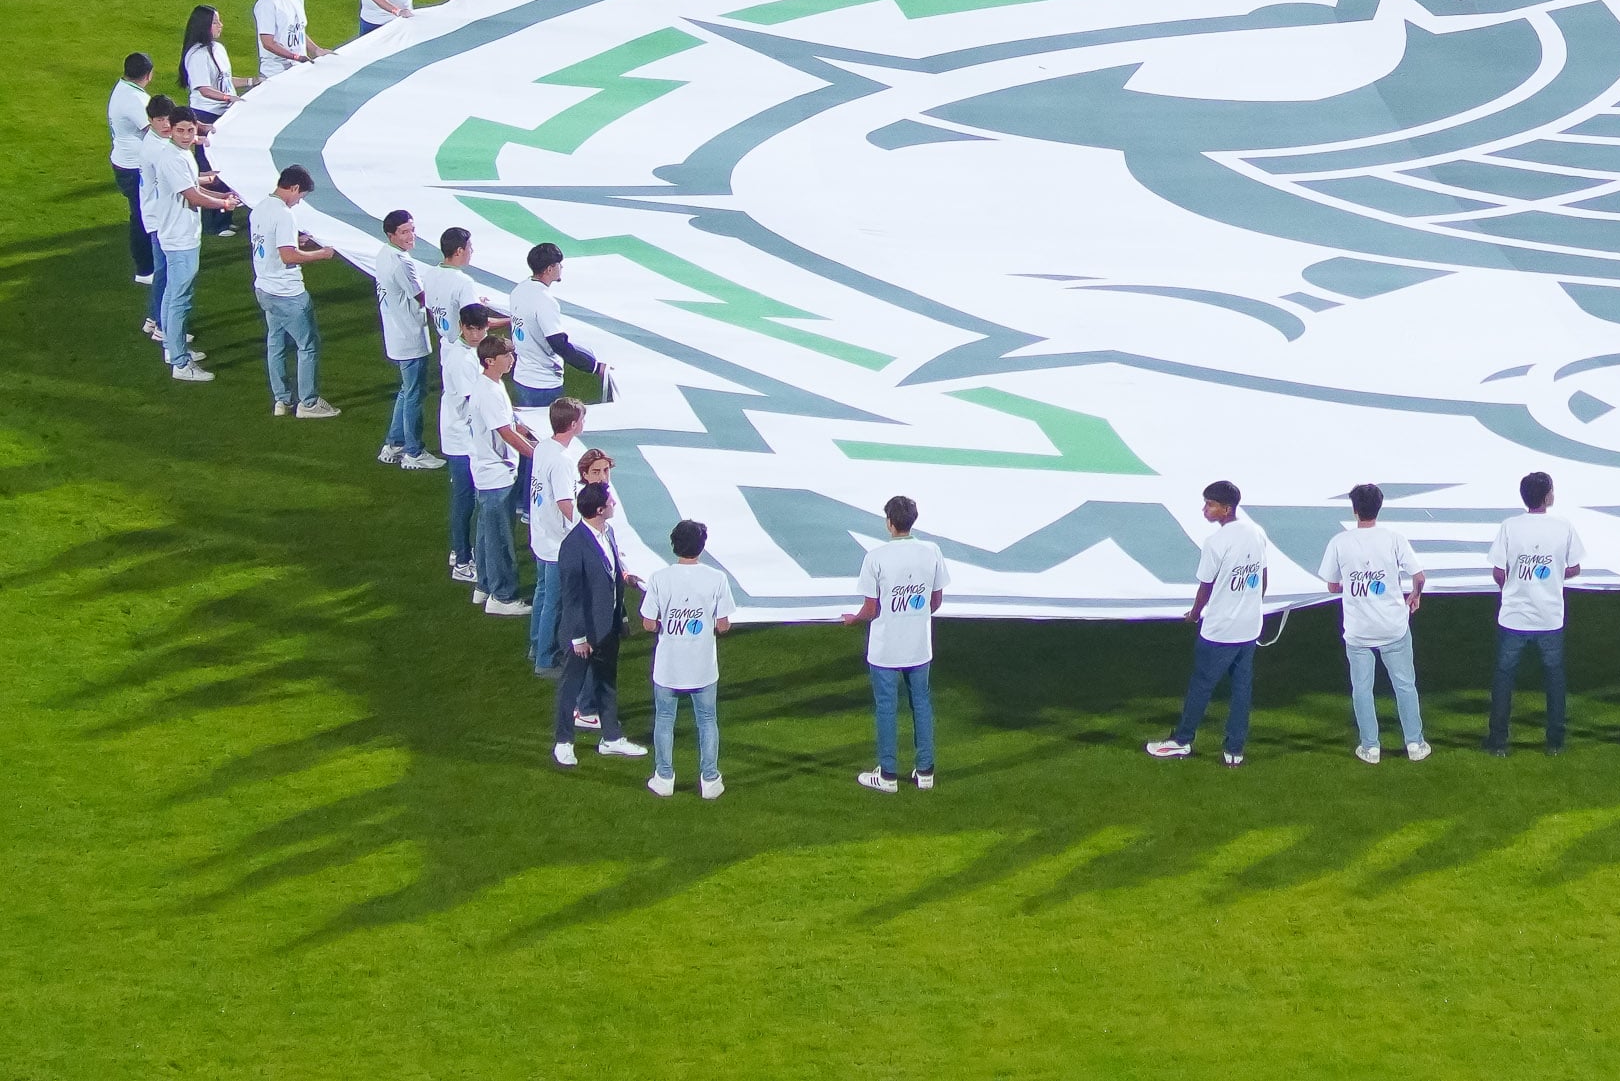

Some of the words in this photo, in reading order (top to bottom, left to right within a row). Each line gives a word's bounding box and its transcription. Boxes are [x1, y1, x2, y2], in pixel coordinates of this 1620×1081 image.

[1518, 554, 1552, 566] SOMOS
[1232, 562, 1260, 577] SOMOS
[1349, 570, 1386, 582] SOMOS
[891, 584, 926, 597] SOMOS
[668, 607, 704, 620] SOMOS
